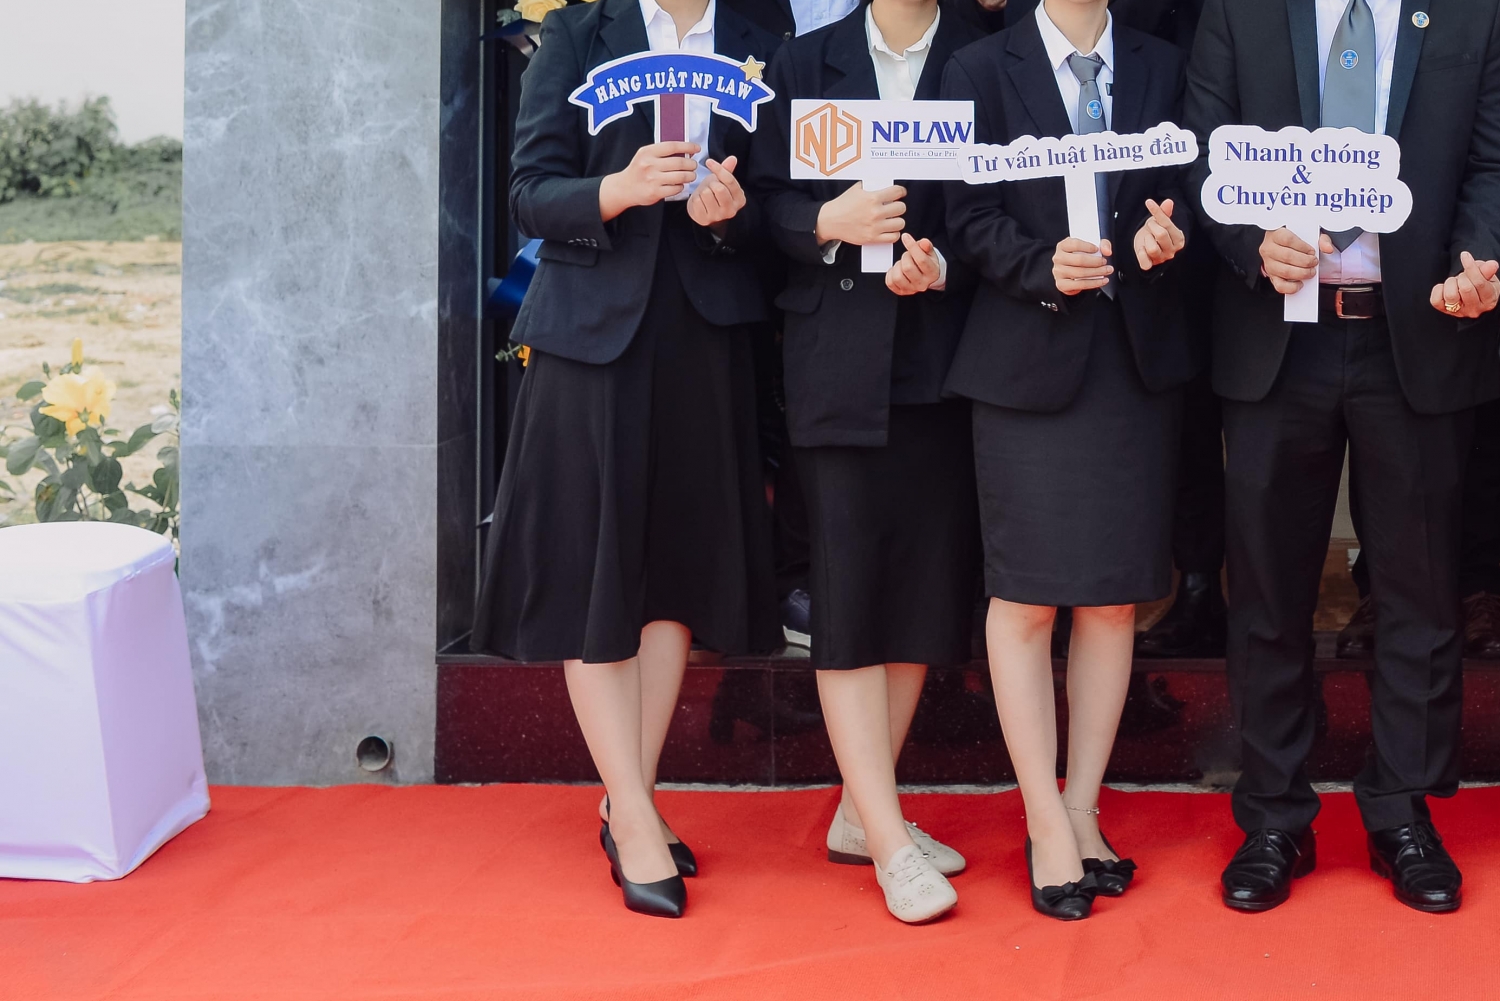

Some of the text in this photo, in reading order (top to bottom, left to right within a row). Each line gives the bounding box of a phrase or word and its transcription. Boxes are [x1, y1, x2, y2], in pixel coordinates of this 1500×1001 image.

[595, 75, 642, 104] HÃNG
[645, 67, 688, 92] LUẬT
[691, 71, 712, 91] NP
[870, 149, 888, 158] Your
[890, 149, 920, 158] Benefits
[927, 149, 943, 158] Our
[968, 131, 1187, 174] Tư vấn luật hàng đầu
[1224, 140, 1380, 169] Nhanh chóng
[1291, 164, 1312, 185] &
[1217, 183, 1393, 214] Chuyên nghiệp
